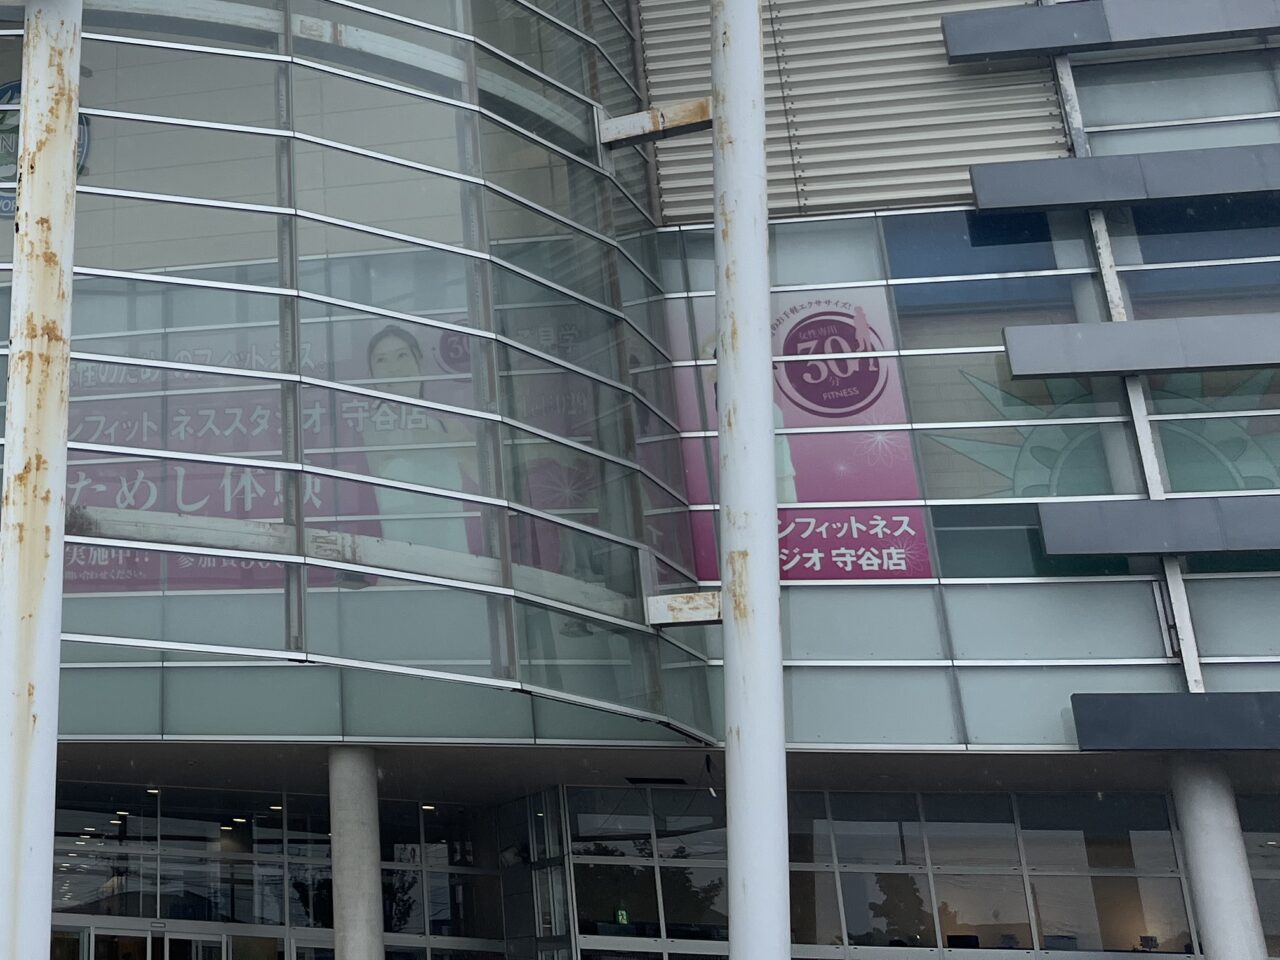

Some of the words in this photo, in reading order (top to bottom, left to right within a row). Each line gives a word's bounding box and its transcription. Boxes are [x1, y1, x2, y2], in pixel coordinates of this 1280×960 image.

[797, 335, 854, 384] 30
[822, 386, 859, 400] FITNESS
[831, 547, 908, 572] 守谷店
